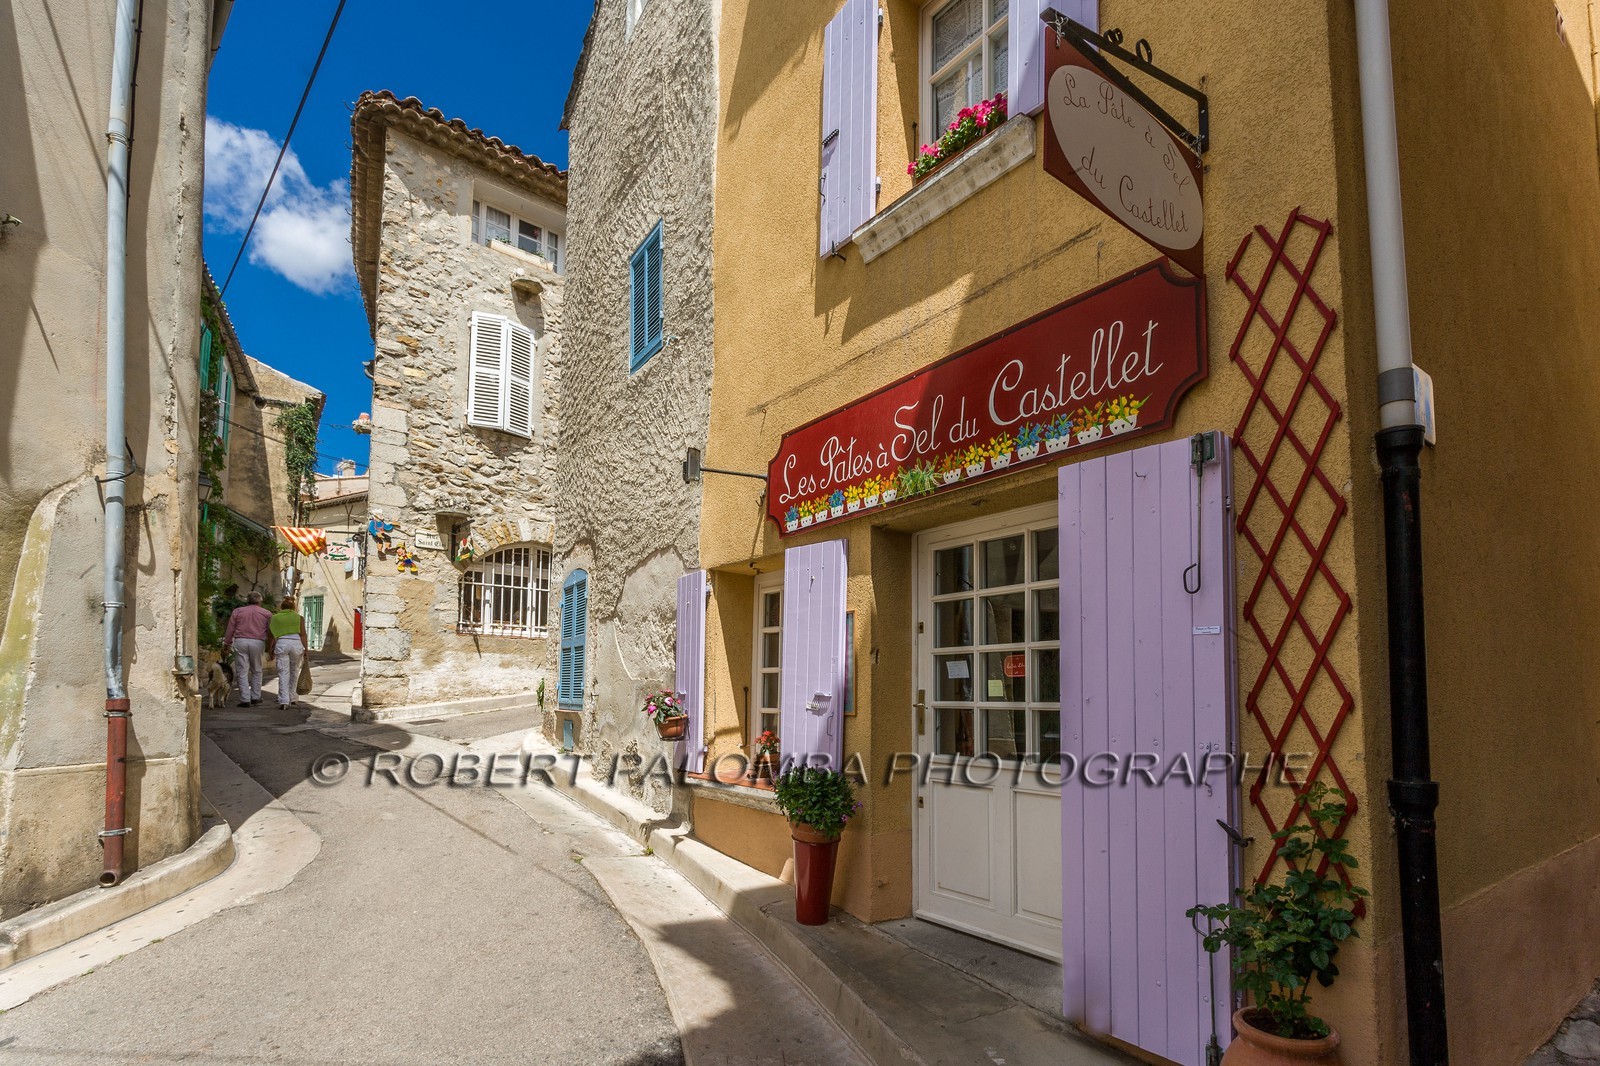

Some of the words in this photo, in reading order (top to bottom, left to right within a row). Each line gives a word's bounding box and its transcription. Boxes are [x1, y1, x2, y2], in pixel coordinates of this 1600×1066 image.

[1063, 72, 1091, 109] La
[1097, 80, 1136, 129] Pâte
[1144, 124, 1156, 149] à
[1081, 146, 1108, 190] du
[1118, 174, 1190, 233] Castellet
[778, 453, 817, 504] Les
[819, 435, 874, 490] Pâtes
[876, 442, 890, 469] à
[890, 394, 944, 463] Sel
[949, 396, 980, 444] du
[988, 319, 1164, 426] Castellet
